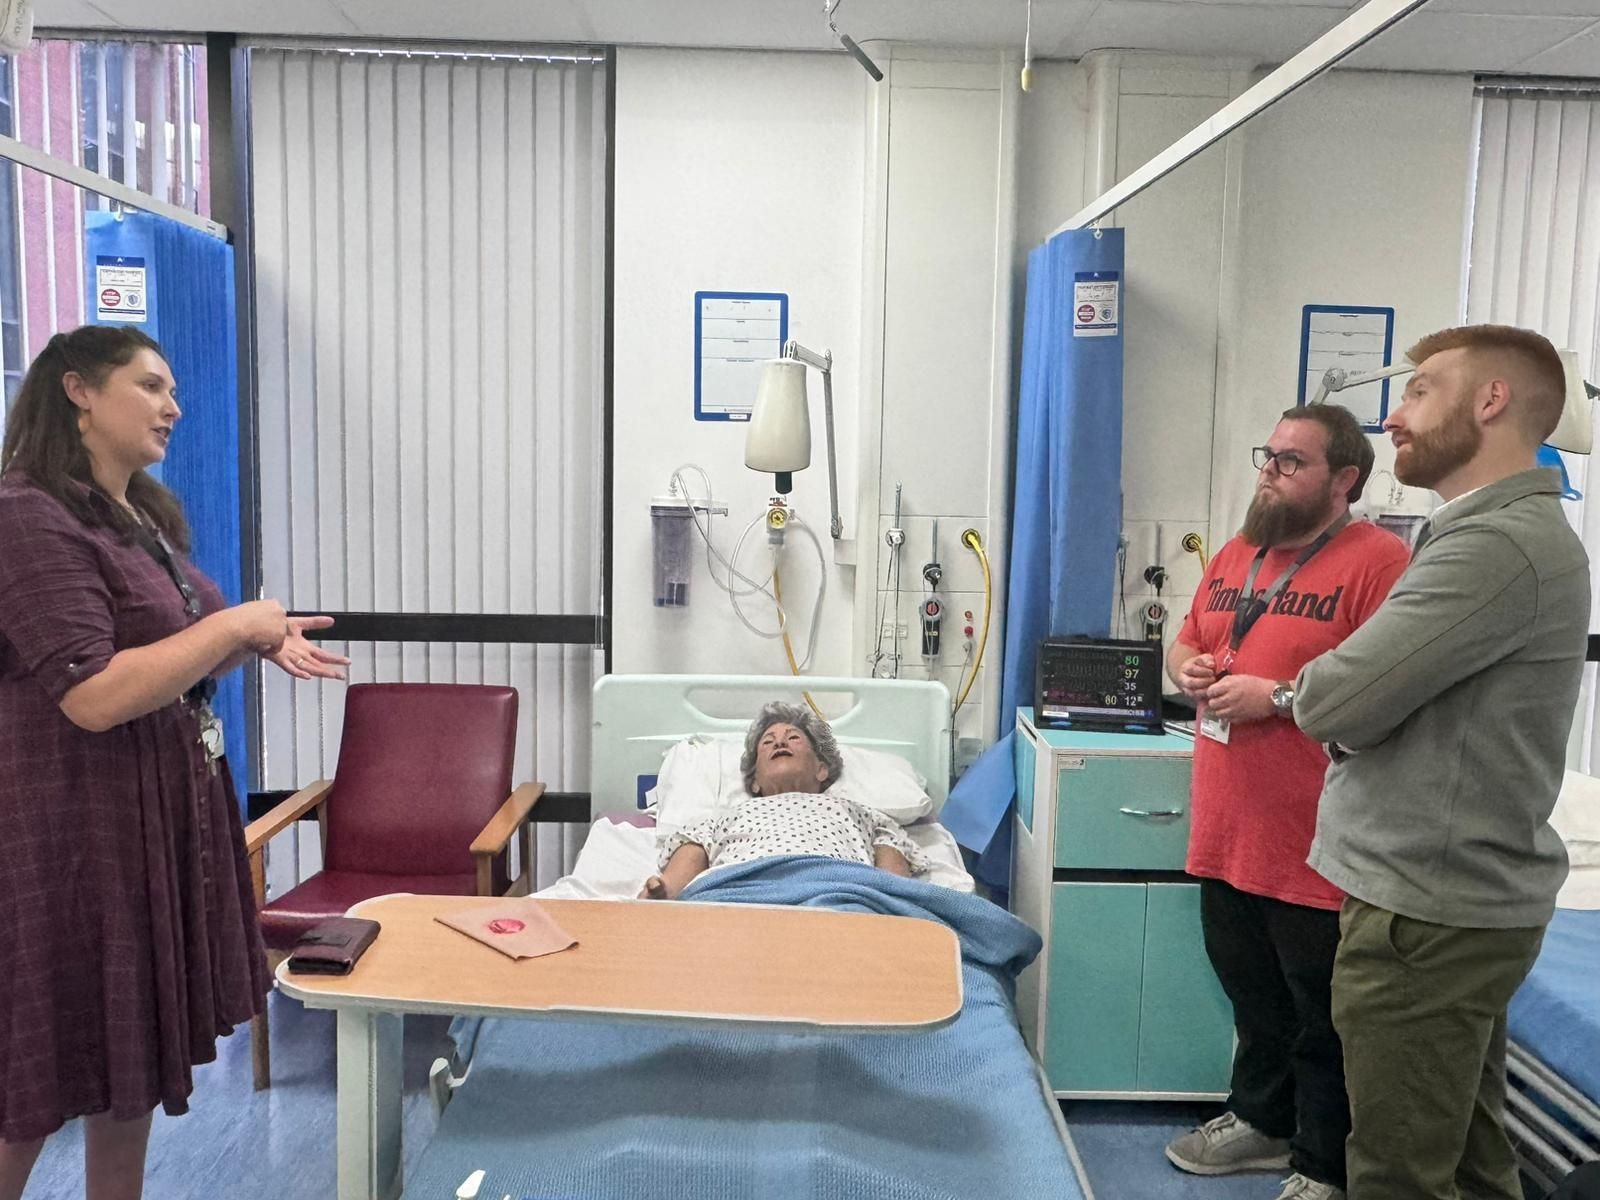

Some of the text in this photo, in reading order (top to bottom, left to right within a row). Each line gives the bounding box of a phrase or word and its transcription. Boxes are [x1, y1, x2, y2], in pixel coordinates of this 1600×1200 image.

[1205, 577, 1344, 622] Timland
[1124, 655, 1140, 666] 80
[1124, 668, 1140, 679] 97
[1124, 695, 1137, 707] 12
